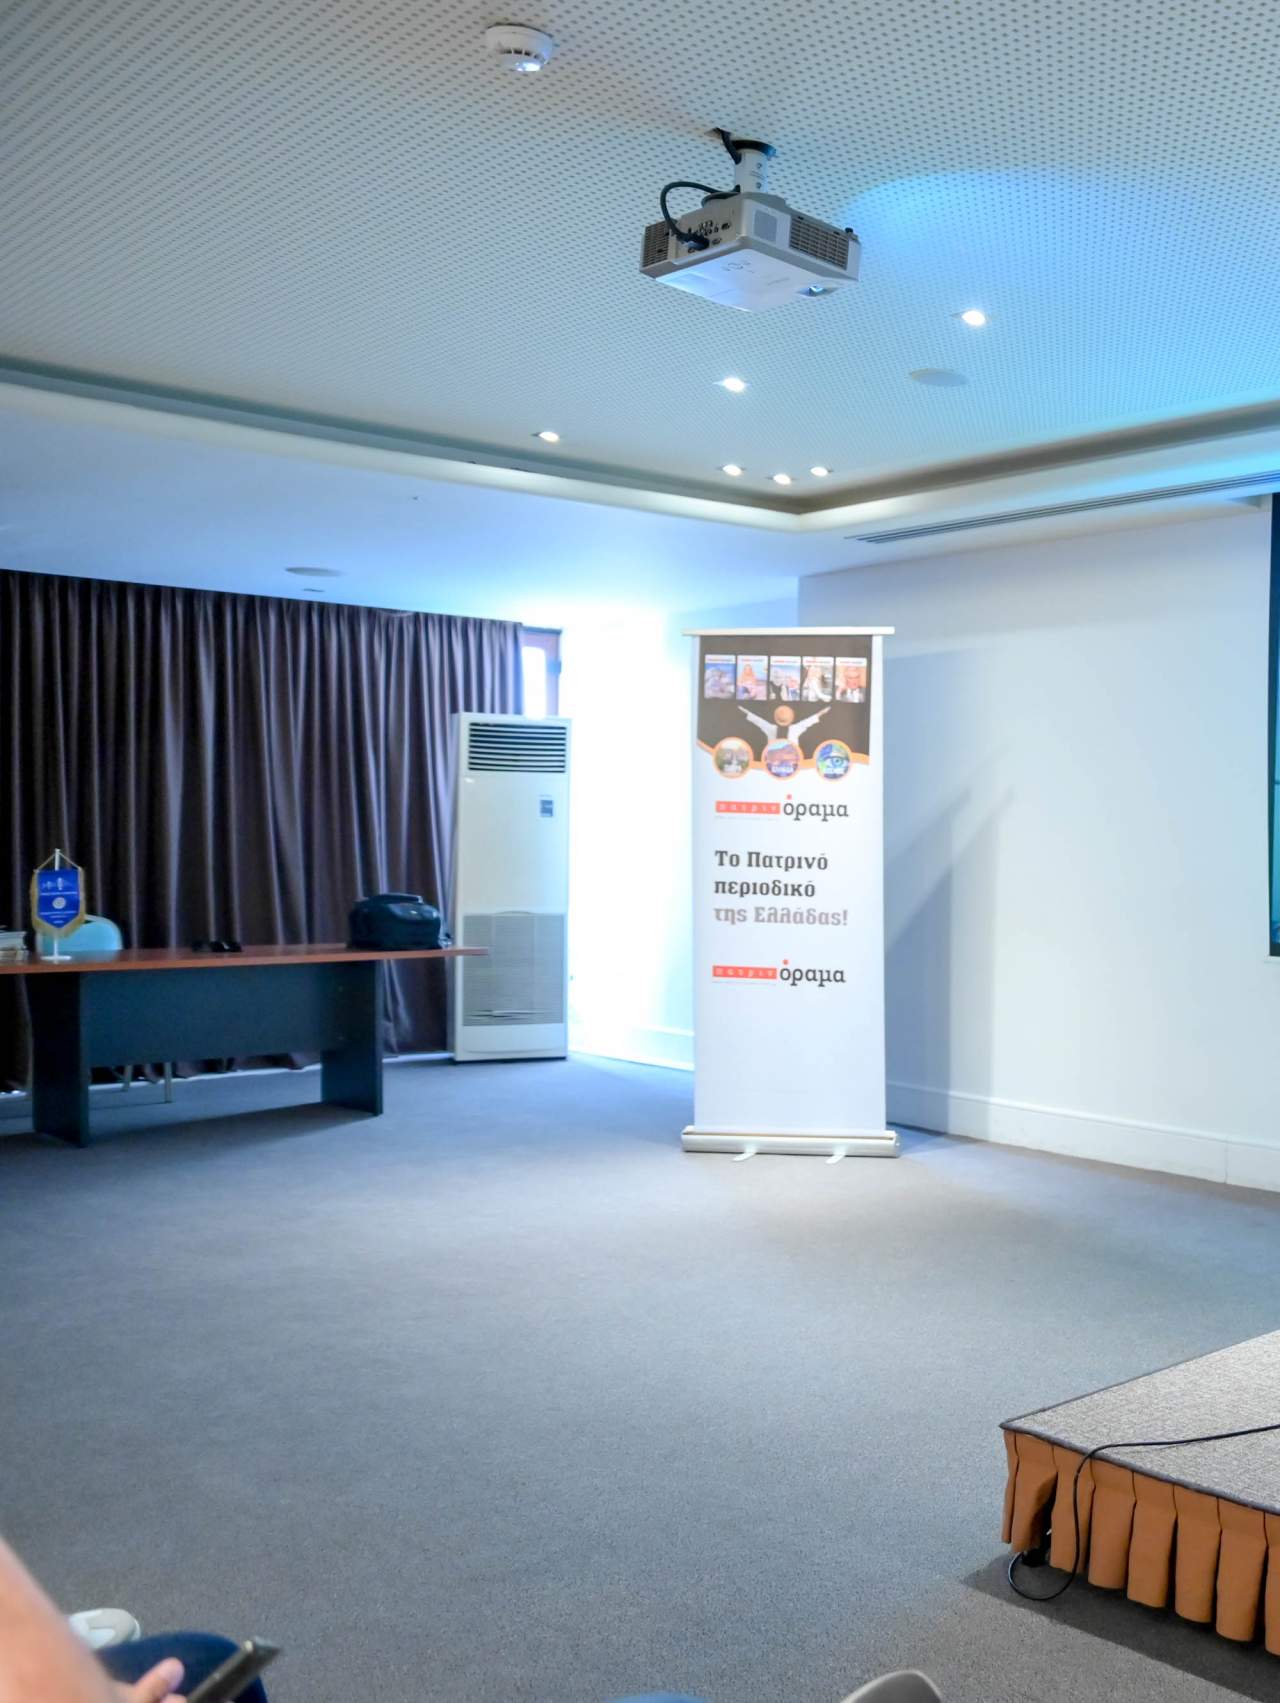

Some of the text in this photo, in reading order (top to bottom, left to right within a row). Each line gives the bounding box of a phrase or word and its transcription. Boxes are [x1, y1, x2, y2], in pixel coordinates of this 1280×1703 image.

[714, 850, 828, 872] Το Πατρινό
[714, 880, 816, 898] περιοδικό
[713, 906, 848, 926] της Ελλάδας!
